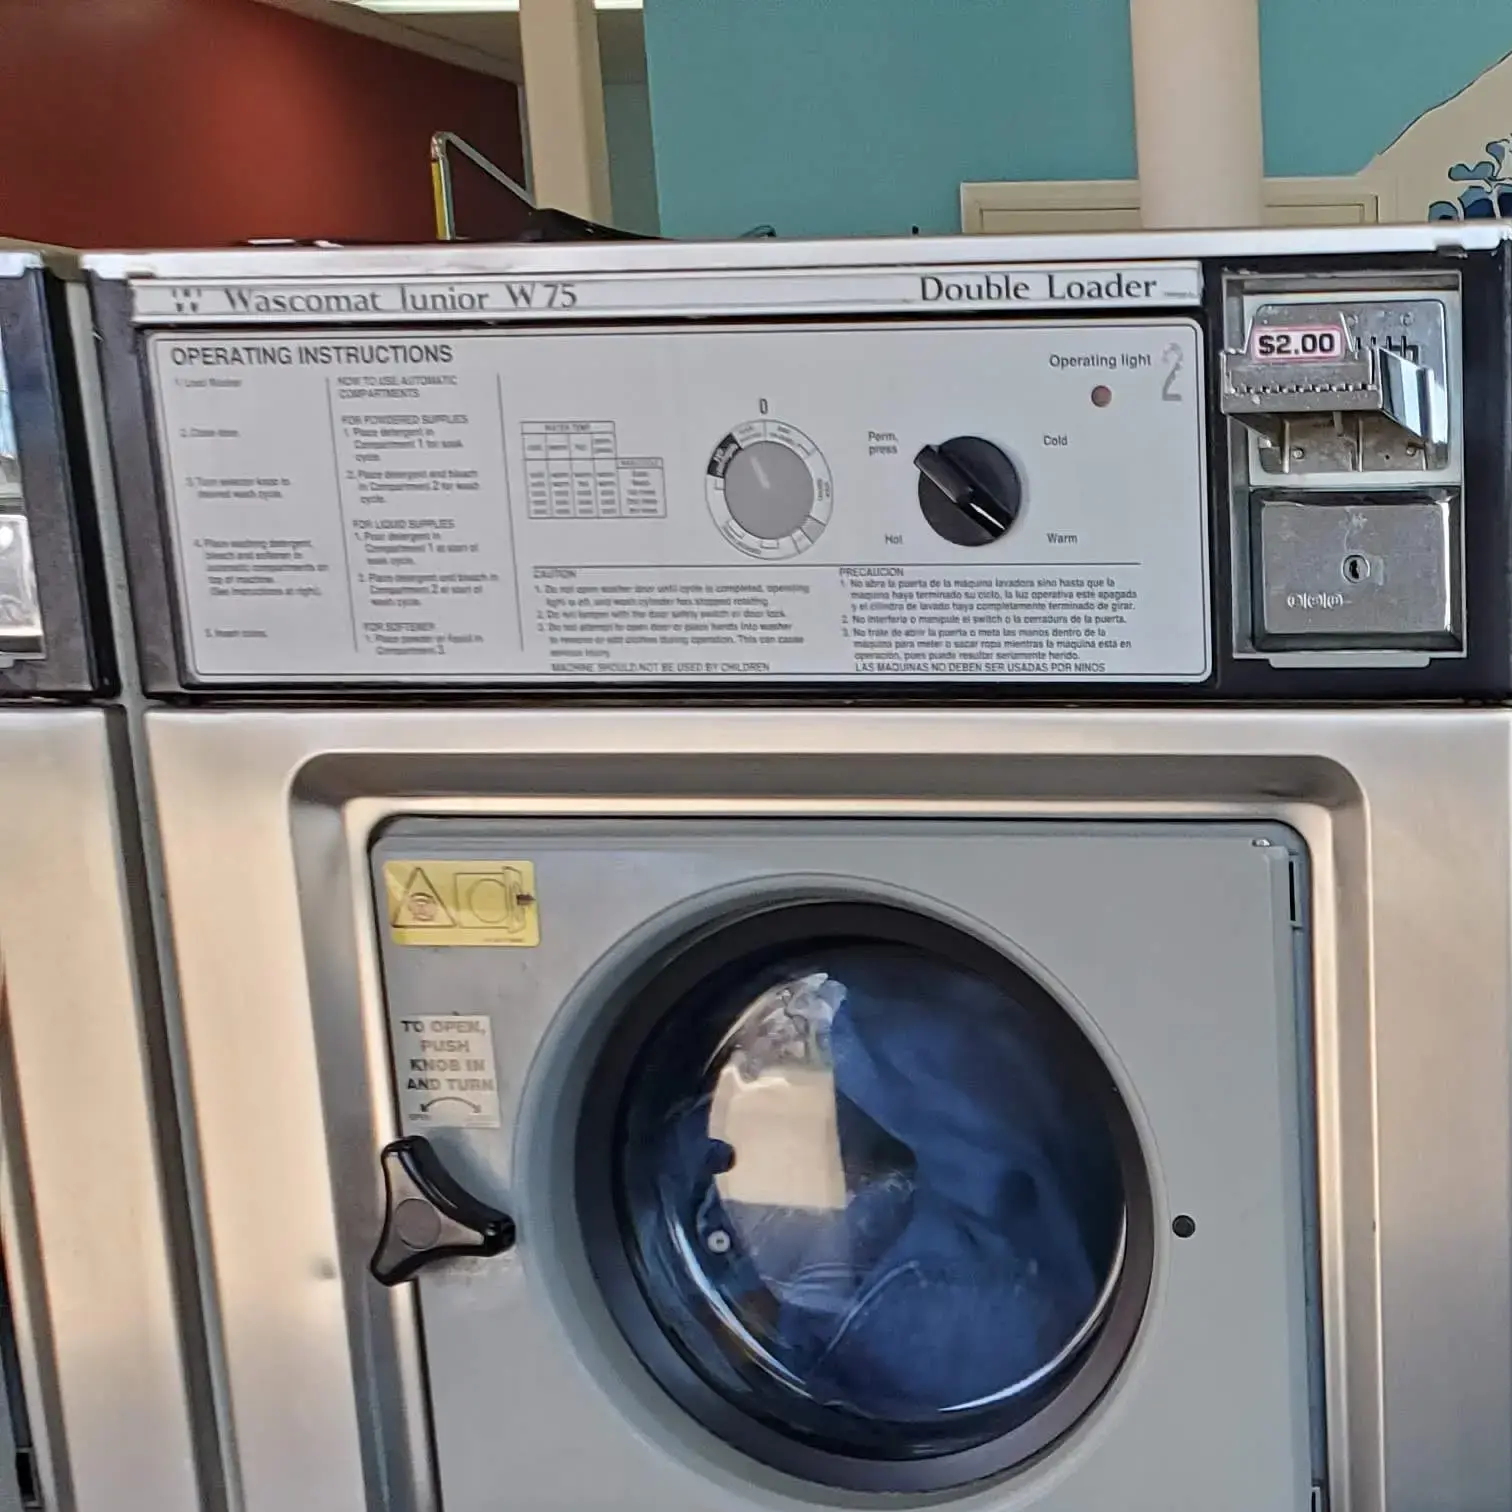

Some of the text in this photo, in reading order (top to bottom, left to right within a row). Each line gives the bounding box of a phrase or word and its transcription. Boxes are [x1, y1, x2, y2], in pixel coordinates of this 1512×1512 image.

[920, 273, 1157, 301] Double Loader
[224, 287, 383, 313] Wascomat
[1258, 333, 1335, 356] $2.00
[171, 344, 454, 366] OPERATING INSTRUCTIONS
[1049, 353, 1151, 370] Operating light
[1161, 342, 1184, 402] 2
[1043, 435, 1068, 447] Cold
[868, 444, 898, 456] press
[885, 534, 903, 545] Hot
[1047, 533, 1078, 544] Warm
[400, 1020, 486, 1036] TO OPEN,
[420, 1039, 470, 1053] PUSH
[409, 1059, 486, 1072] KNOB IN
[407, 1078, 495, 1092] AND TURN
